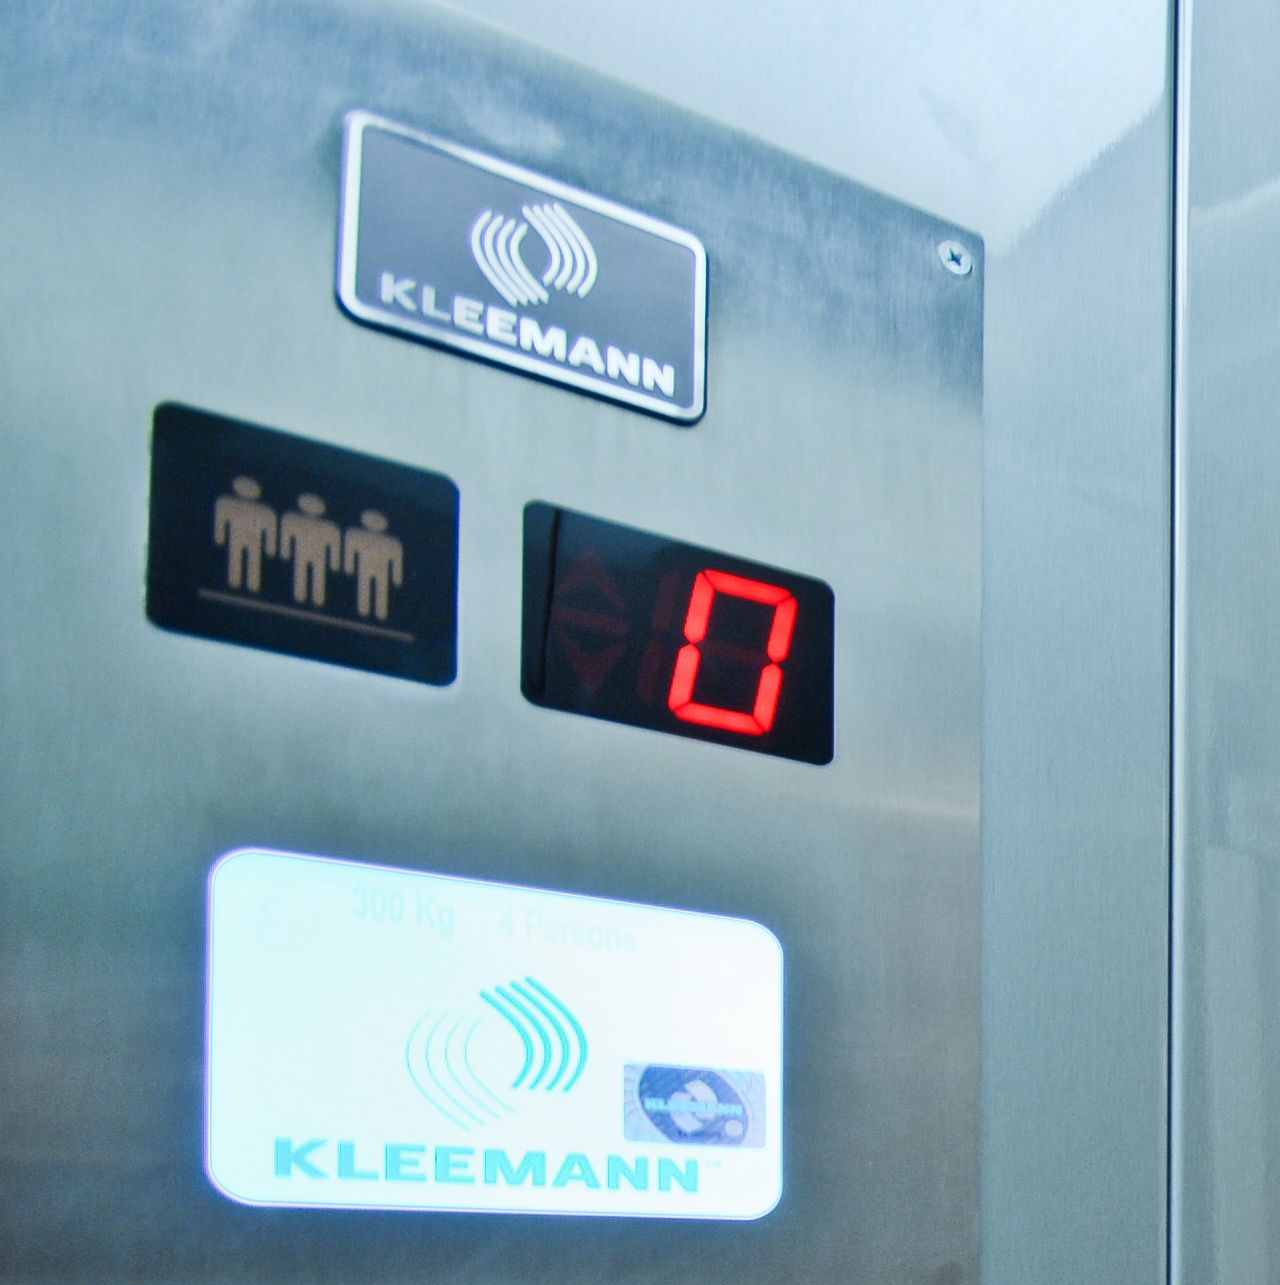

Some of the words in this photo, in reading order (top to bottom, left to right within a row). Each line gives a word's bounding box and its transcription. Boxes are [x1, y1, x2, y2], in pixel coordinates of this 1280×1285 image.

[379, 270, 675, 396] KLEEMANN
[668, 568, 797, 735] 0
[350, 884, 403, 922] 300
[414, 893, 456, 938] Kg
[524, 907, 638, 953] Persons
[274, 1136, 699, 1193] KLEEMANN
